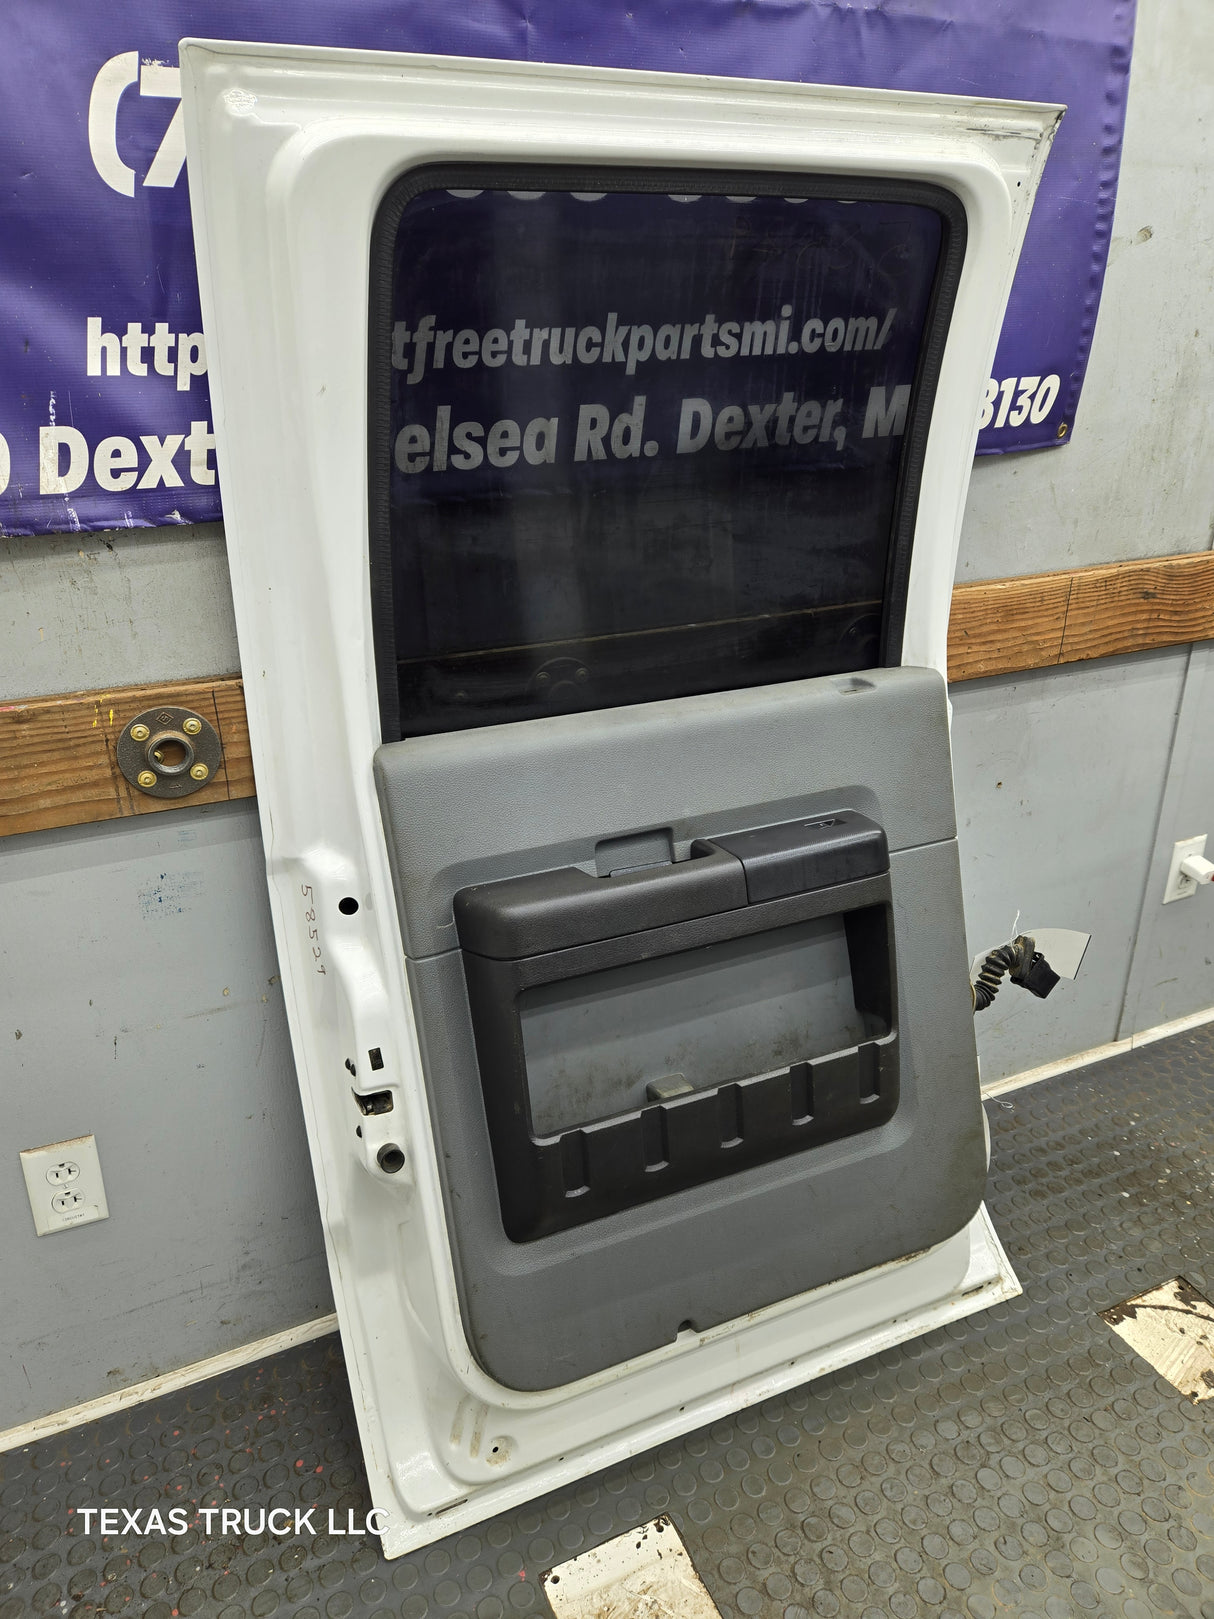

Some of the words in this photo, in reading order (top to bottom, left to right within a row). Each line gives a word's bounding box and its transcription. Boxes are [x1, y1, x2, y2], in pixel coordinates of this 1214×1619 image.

[87, 317, 208, 391] http
[39, 421, 218, 495] Dext
[394, 405, 560, 474] elsea
[573, 395, 660, 462] Rd.
[676, 391, 847, 455] Dexter,
